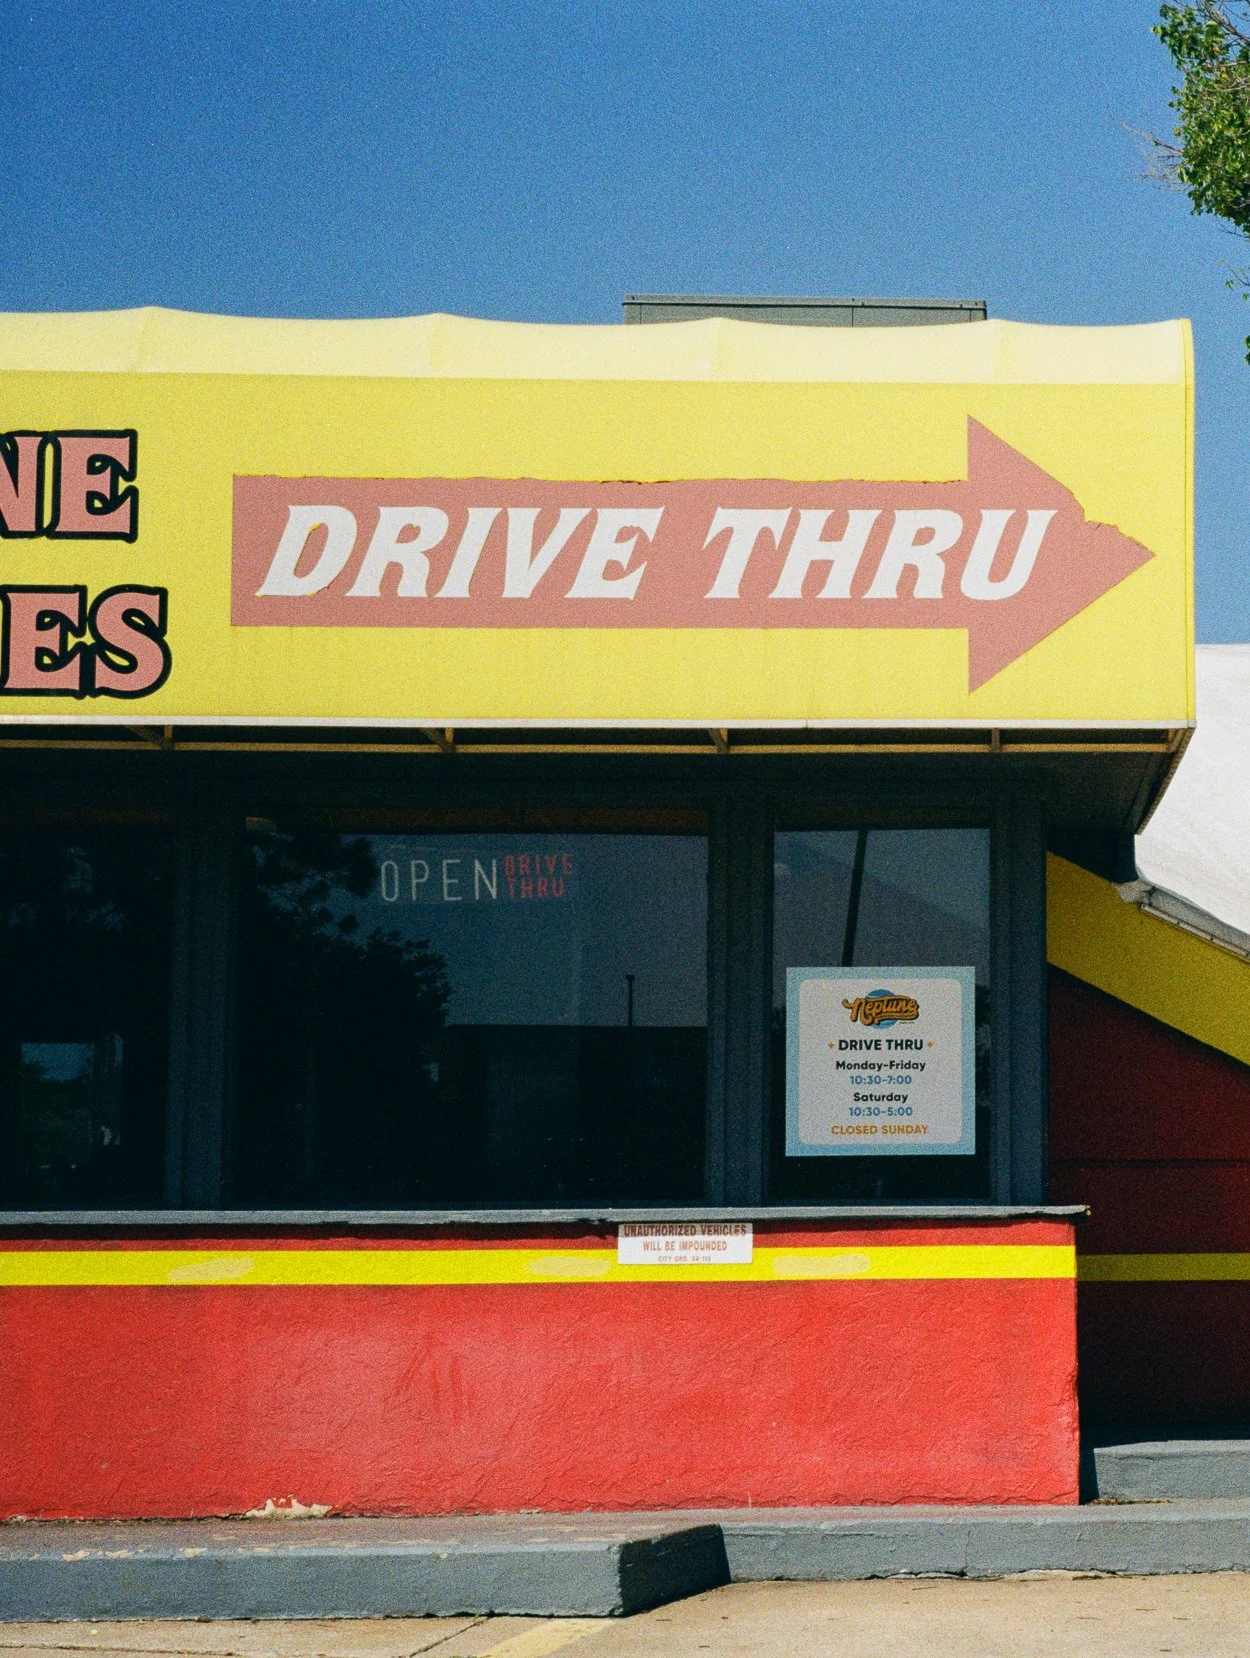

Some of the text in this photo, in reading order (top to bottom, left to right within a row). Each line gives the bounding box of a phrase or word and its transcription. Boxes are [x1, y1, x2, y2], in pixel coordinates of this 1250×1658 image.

[255, 504, 1059, 601] DRIVE THRU
[0, 584, 172, 700] ES
[503, 853, 574, 877] DRIVE
[380, 858, 498, 902] OPEN
[508, 876, 565, 899] THRU
[841, 995, 920, 1026] Neptune
[838, 1039, 924, 1051] DRIVE THRU
[835, 1060, 926, 1072] Monday-Friday
[850, 1075, 912, 1085] 10:30-7:00
[853, 1092, 909, 1104] Saturday
[849, 1107, 913, 1117] 10:30-5:00
[831, 1124, 929, 1136] CLOSED SUNDAY
[623, 1224, 748, 1237] UNAUTHORIZED VEHICLES
[643, 1240, 728, 1251] WILL BE IMPOUNDED
